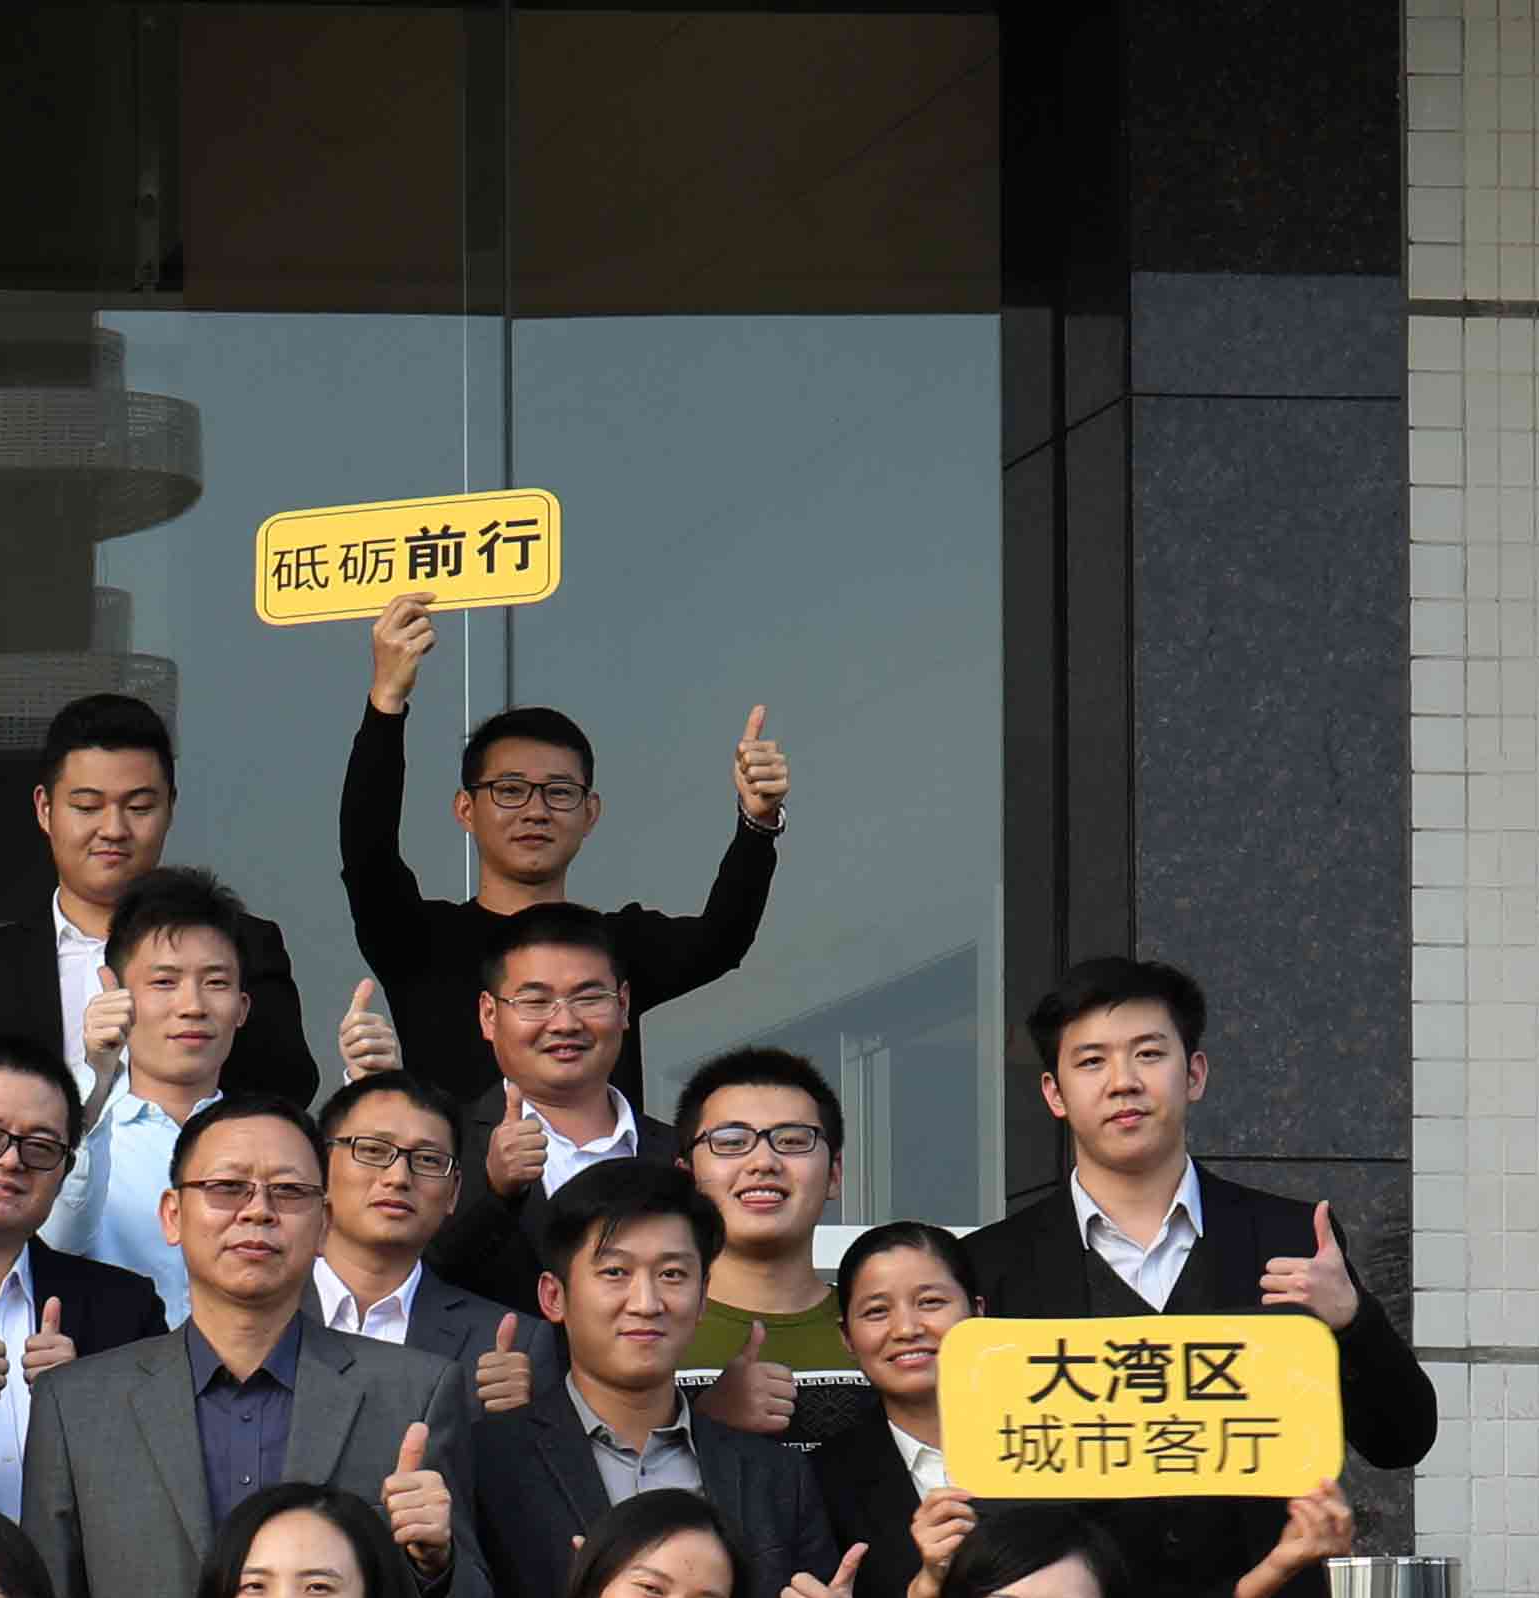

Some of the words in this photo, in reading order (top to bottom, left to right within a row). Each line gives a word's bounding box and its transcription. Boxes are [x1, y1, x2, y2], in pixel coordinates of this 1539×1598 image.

[270, 518, 542, 592] 砥砺前行
[1026, 1338, 1249, 1404] 大湾区
[996, 1414, 1282, 1475] 城市客厅
